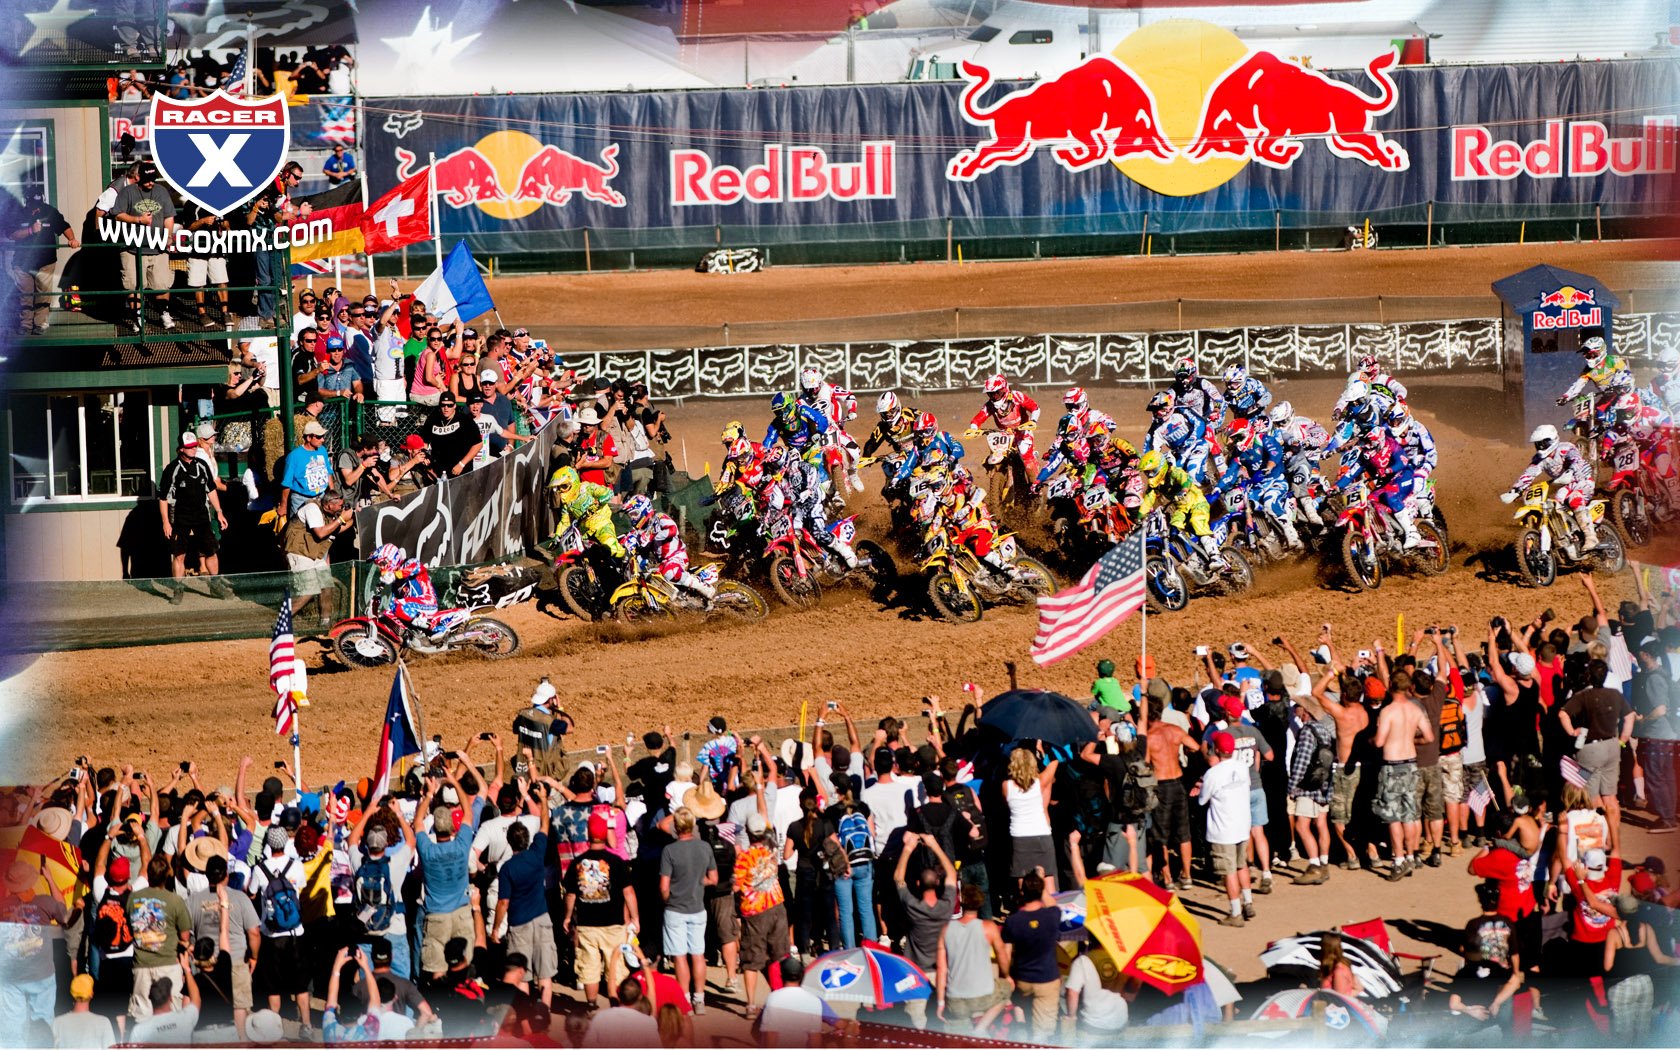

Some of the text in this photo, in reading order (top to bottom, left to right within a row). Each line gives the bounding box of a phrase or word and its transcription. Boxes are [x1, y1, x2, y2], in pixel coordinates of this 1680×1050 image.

[1453, 117, 1676, 179] Red Bull
[672, 142, 894, 204] Red Bull
[1533, 307, 1601, 328] Red Bull
[992, 435, 1008, 446] 30
[1618, 453, 1634, 469] 28
[1049, 480, 1067, 497] 13
[1525, 487, 1543, 501] 69
[1086, 491, 1105, 507] 37
[1229, 493, 1243, 506] 18
